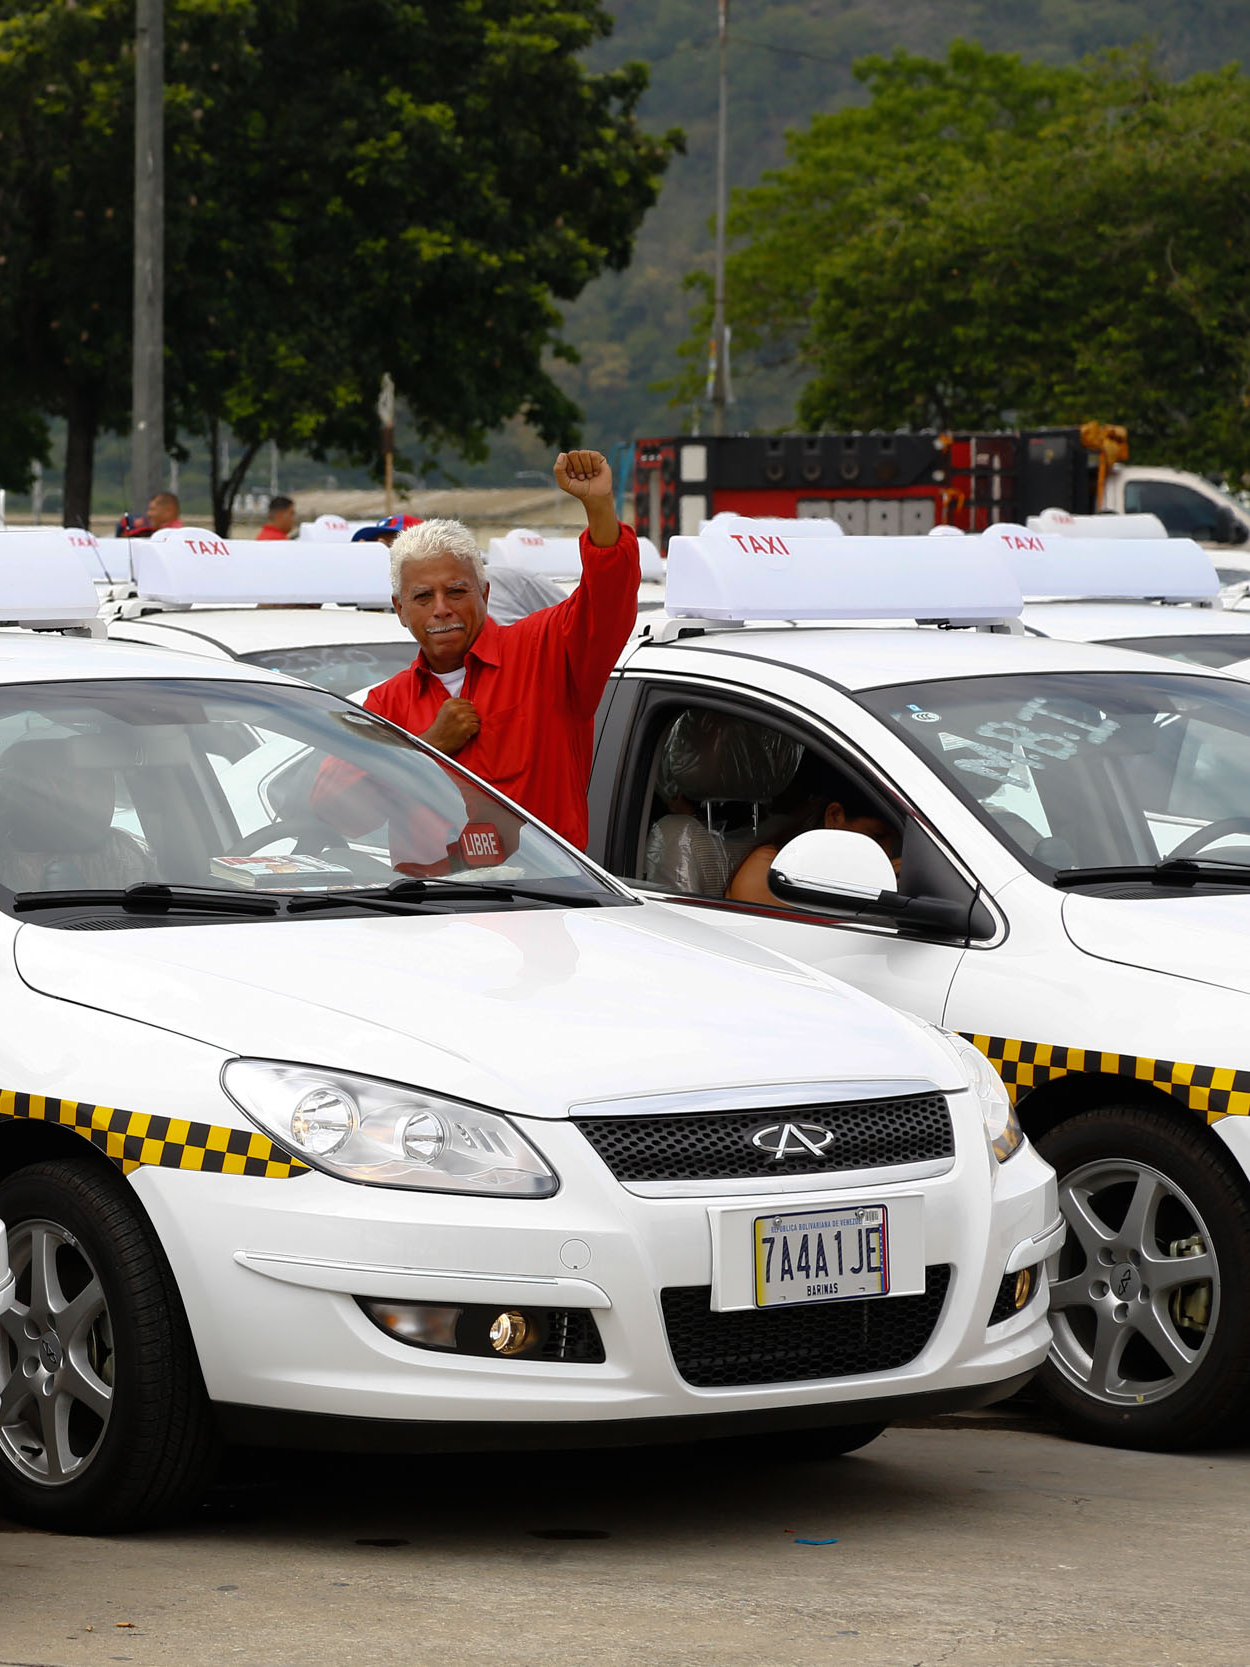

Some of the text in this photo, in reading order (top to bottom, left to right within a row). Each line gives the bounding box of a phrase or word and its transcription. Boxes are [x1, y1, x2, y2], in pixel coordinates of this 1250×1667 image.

[184, 540, 230, 556] TAXI
[730, 534, 791, 555] TAXI
[1000, 536, 1045, 552] TAXI
[463, 833, 499, 856] LIBRE
[798, 1220, 831, 1231] BOLIVARIANA
[832, 1219, 839, 1227] DE
[840, 1217, 863, 1227] VENEZUE
[761, 1226, 881, 1283] 7A4A1JE
[806, 1282, 839, 1297] BARINAS
